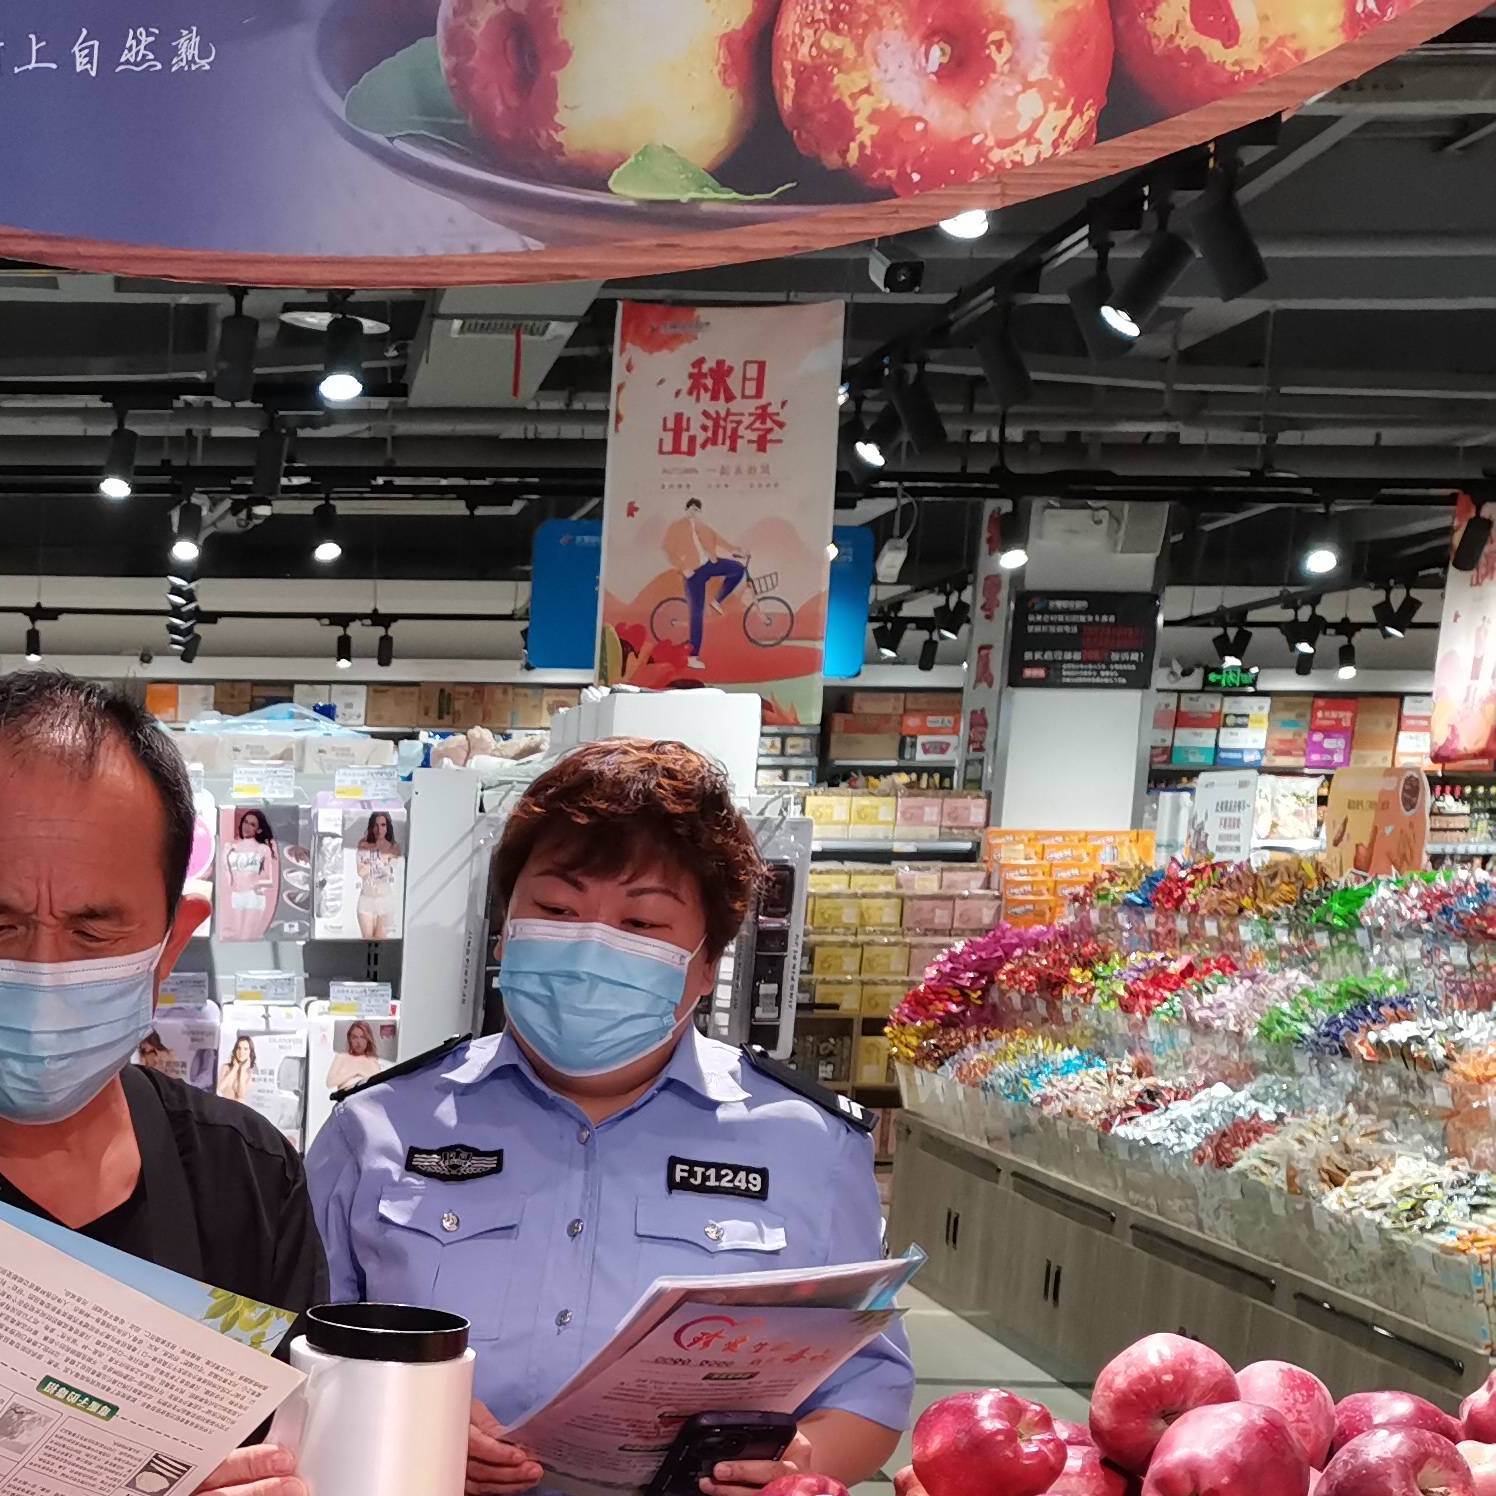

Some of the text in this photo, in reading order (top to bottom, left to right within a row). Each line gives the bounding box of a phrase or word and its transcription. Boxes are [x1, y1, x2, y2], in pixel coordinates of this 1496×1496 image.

[686, 356, 767, 404] 秋日
[657, 401, 788, 458] 出游季
[674, 1163, 763, 1193] FJ1249
